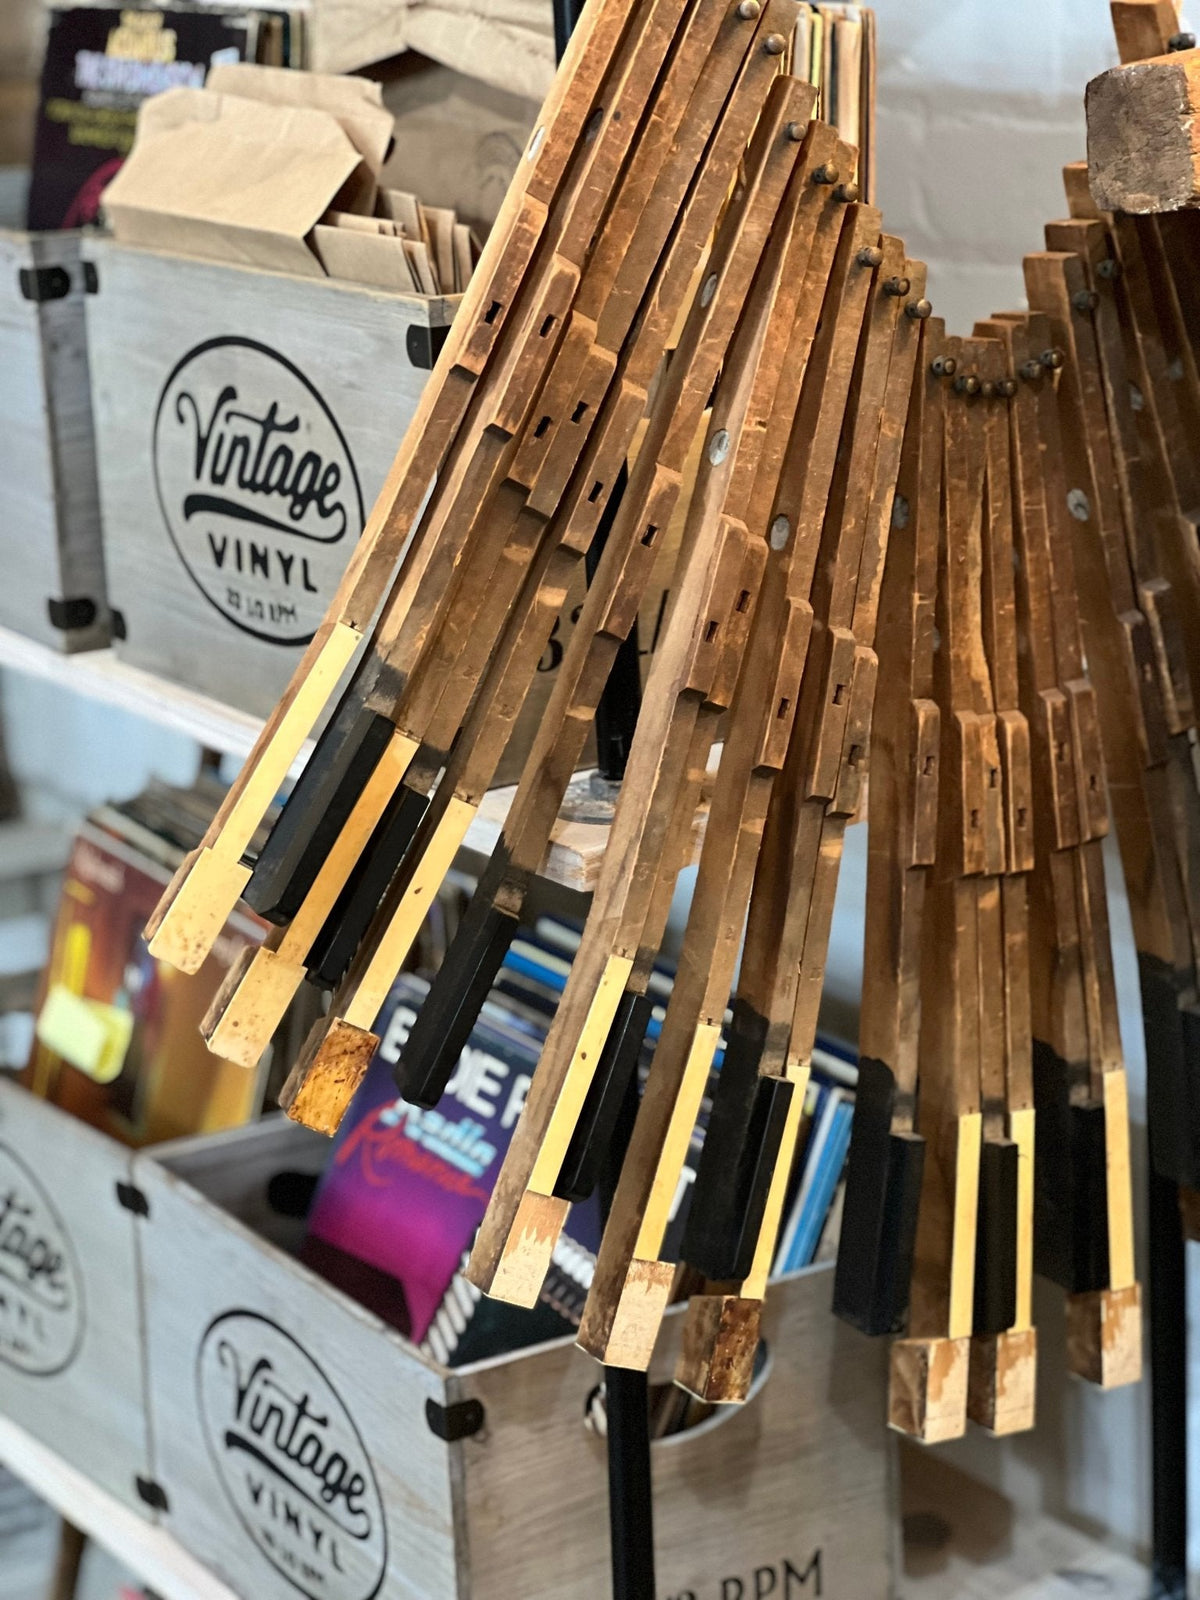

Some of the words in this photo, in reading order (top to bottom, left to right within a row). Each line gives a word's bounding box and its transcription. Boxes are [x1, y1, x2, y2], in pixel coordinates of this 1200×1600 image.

[177, 386, 345, 522] Vintage
[208, 532, 317, 593] VINYL
[0, 1190, 63, 1284] tage
[218, 1339, 368, 1516] Vintage
[246, 1472, 344, 1574] VINYL
